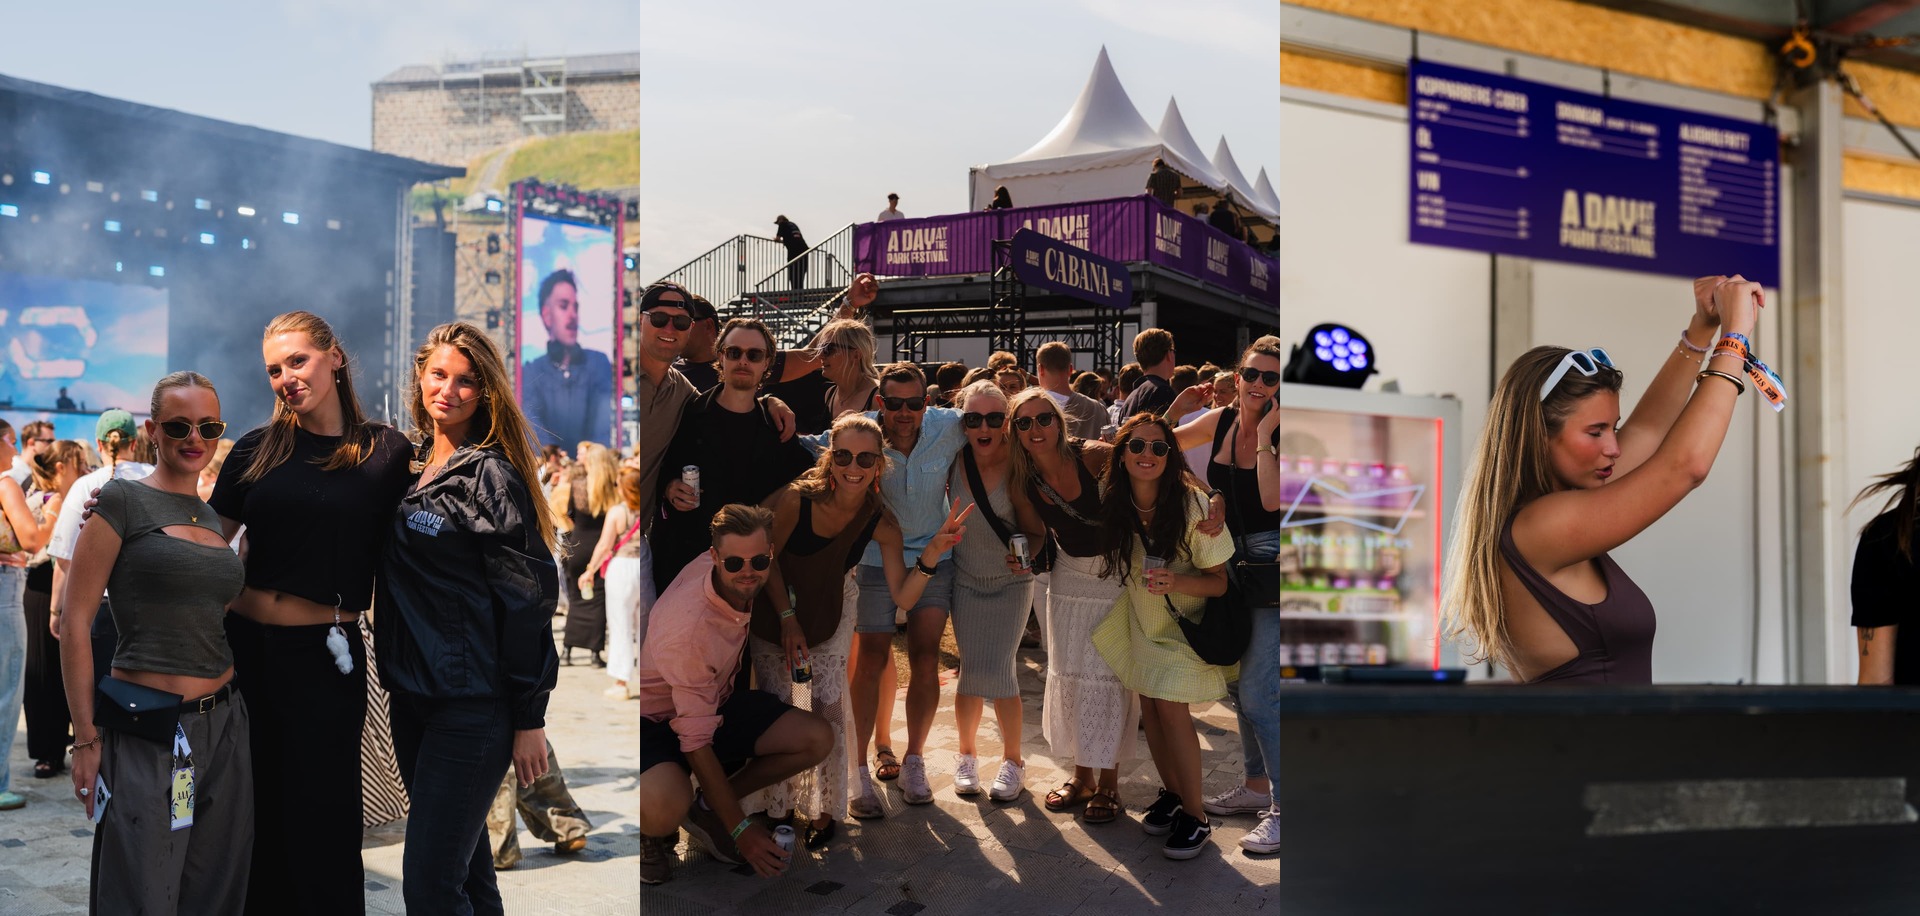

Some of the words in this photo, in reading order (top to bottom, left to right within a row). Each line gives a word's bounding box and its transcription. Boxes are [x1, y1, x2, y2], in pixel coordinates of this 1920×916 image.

[1561, 188, 1581, 225] A
[1583, 191, 1637, 233] DAY
[1038, 215, 1075, 241] DAY
[1076, 214, 1090, 227] AT
[1076, 228, 1089, 239] THE
[1155, 212, 1162, 238] A
[887, 230, 899, 251] A
[902, 227, 935, 251] DAY
[935, 226, 948, 239] AT
[935, 240, 948, 250] THE
[887, 252, 910, 264] PARK
[911, 250, 948, 263] FESTIVAL
[1044, 247, 1111, 297] CABANA
[413, 510, 438, 527] DAY
[434, 515, 446, 525] AT
